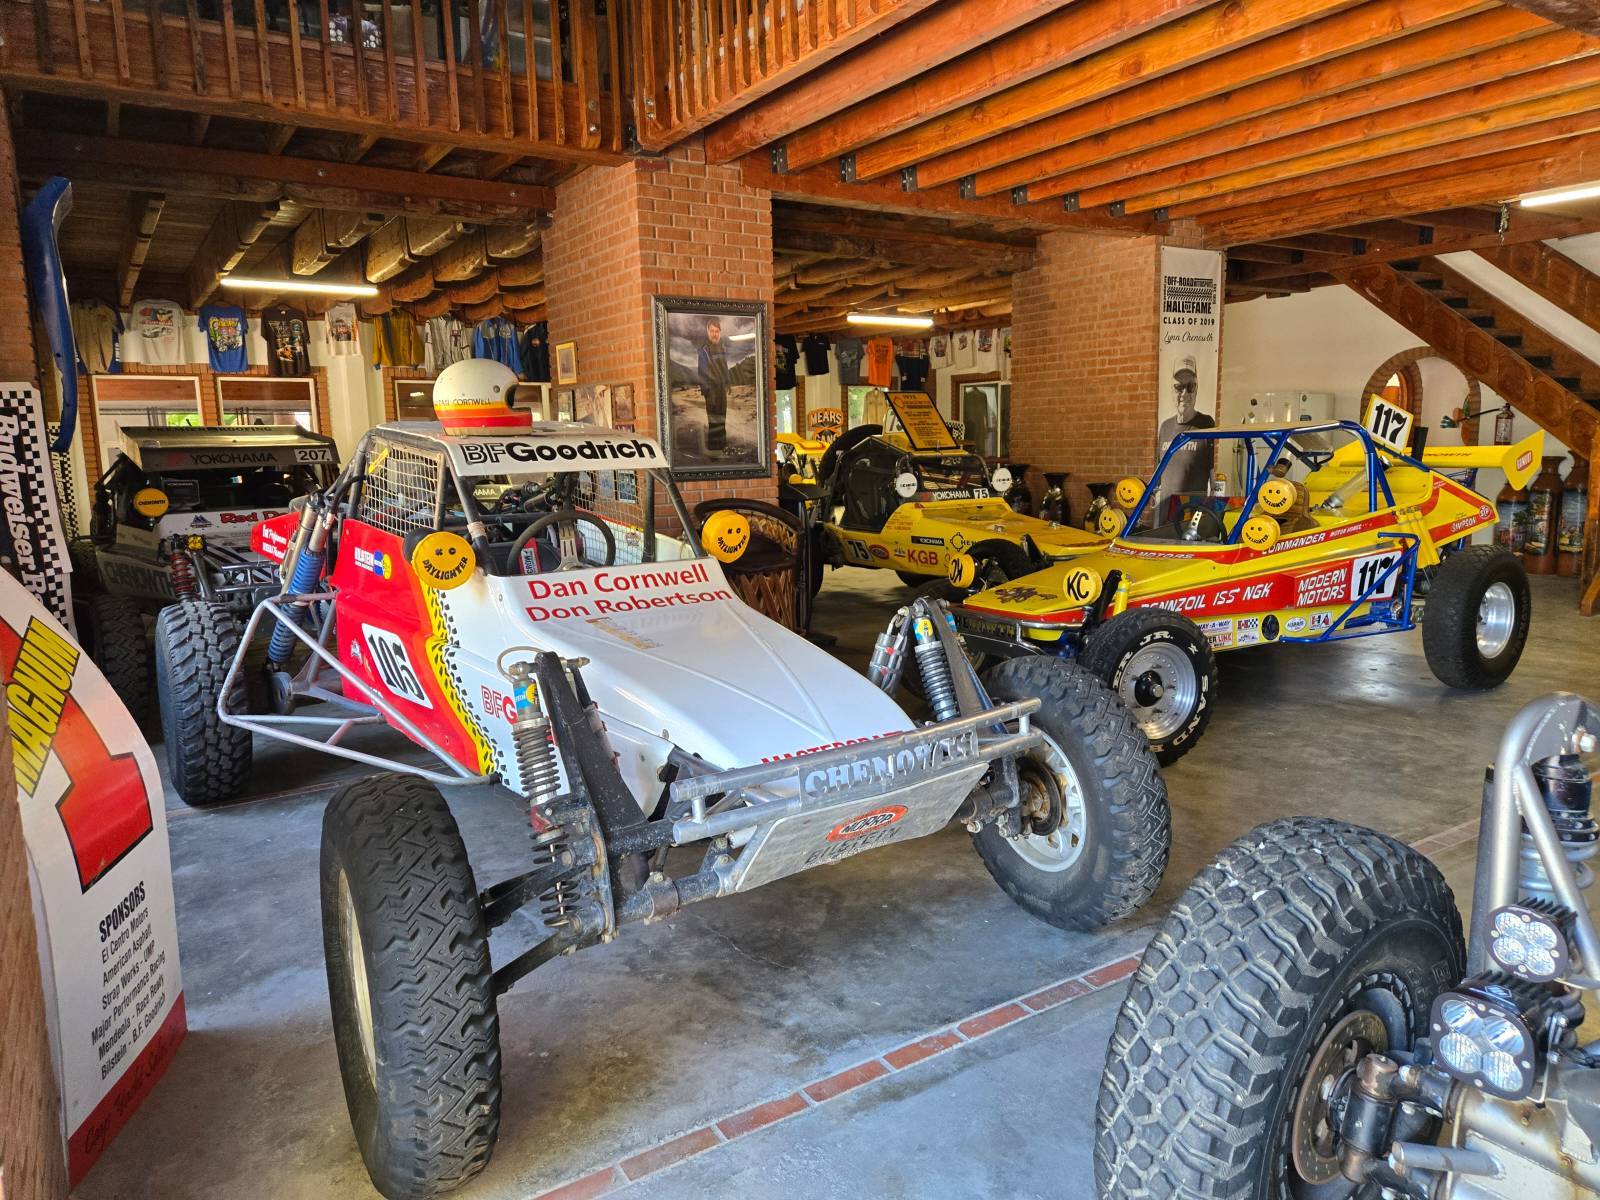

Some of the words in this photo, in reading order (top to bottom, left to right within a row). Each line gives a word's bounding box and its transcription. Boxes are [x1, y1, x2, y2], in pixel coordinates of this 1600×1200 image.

[1167, 276, 1194, 287] OFF-ROAD
[1166, 301, 1185, 313] HALL
[1191, 301, 1212, 314] FAME
[1163, 317, 1185, 325] CLASS
[1200, 318, 1215, 326] 2019
[810, 411, 842, 426] MEARS
[1372, 402, 1408, 444] 117
[190, 451, 278, 464] YOKOHAMA
[298, 449, 327, 461] 207
[460, 439, 657, 465] BFGoodrich
[933, 490, 971, 500] YOKOHAMA
[974, 489, 988, 499] 75
[220, 512, 258, 524] Red
[1451, 516, 1477, 533] SIMPSON
[717, 535, 747, 556] DAYLIGHTER
[848, 540, 870, 560] 75
[907, 548, 939, 566] KGB
[1139, 551, 1194, 559] MOTORS
[422, 556, 469, 581] DAYLIGHTER
[1297, 568, 1348, 593] MODERN
[527, 579, 588, 600] Dan
[593, 563, 710, 593] Cornwell
[1066, 571, 1090, 602] KC
[1242, 581, 1274, 601] NGK
[525, 604, 590, 622] Don
[593, 590, 733, 615] Robertson
[1296, 583, 1346, 607] MOTORS
[368, 633, 426, 701] 105
[8, 615, 81, 798] MAGNUM
[99, 881, 147, 943] SPONSORS
[101, 949, 109, 963] El
[109, 931, 130, 960] Centro
[130, 907, 149, 933] Motors
[102, 948, 132, 988] American
[132, 922, 152, 957] Asphalt
[101, 985, 120, 1011] Strap
[120, 964, 141, 997] Works
[143, 941, 156, 962] UMP
[91, 1015, 112, 1046] Major
[112, 974, 150, 1022] Performance
[149, 948, 166, 981] Racing
[98, 1020, 131, 1061] Mendeola
[135, 995, 149, 1019] Race
[149, 972, 165, 1000] Ready
[101, 1044, 128, 1081] Bilstein
[132, 1021, 144, 1044] B.F.
[144, 990, 166, 1030] Goodrich
